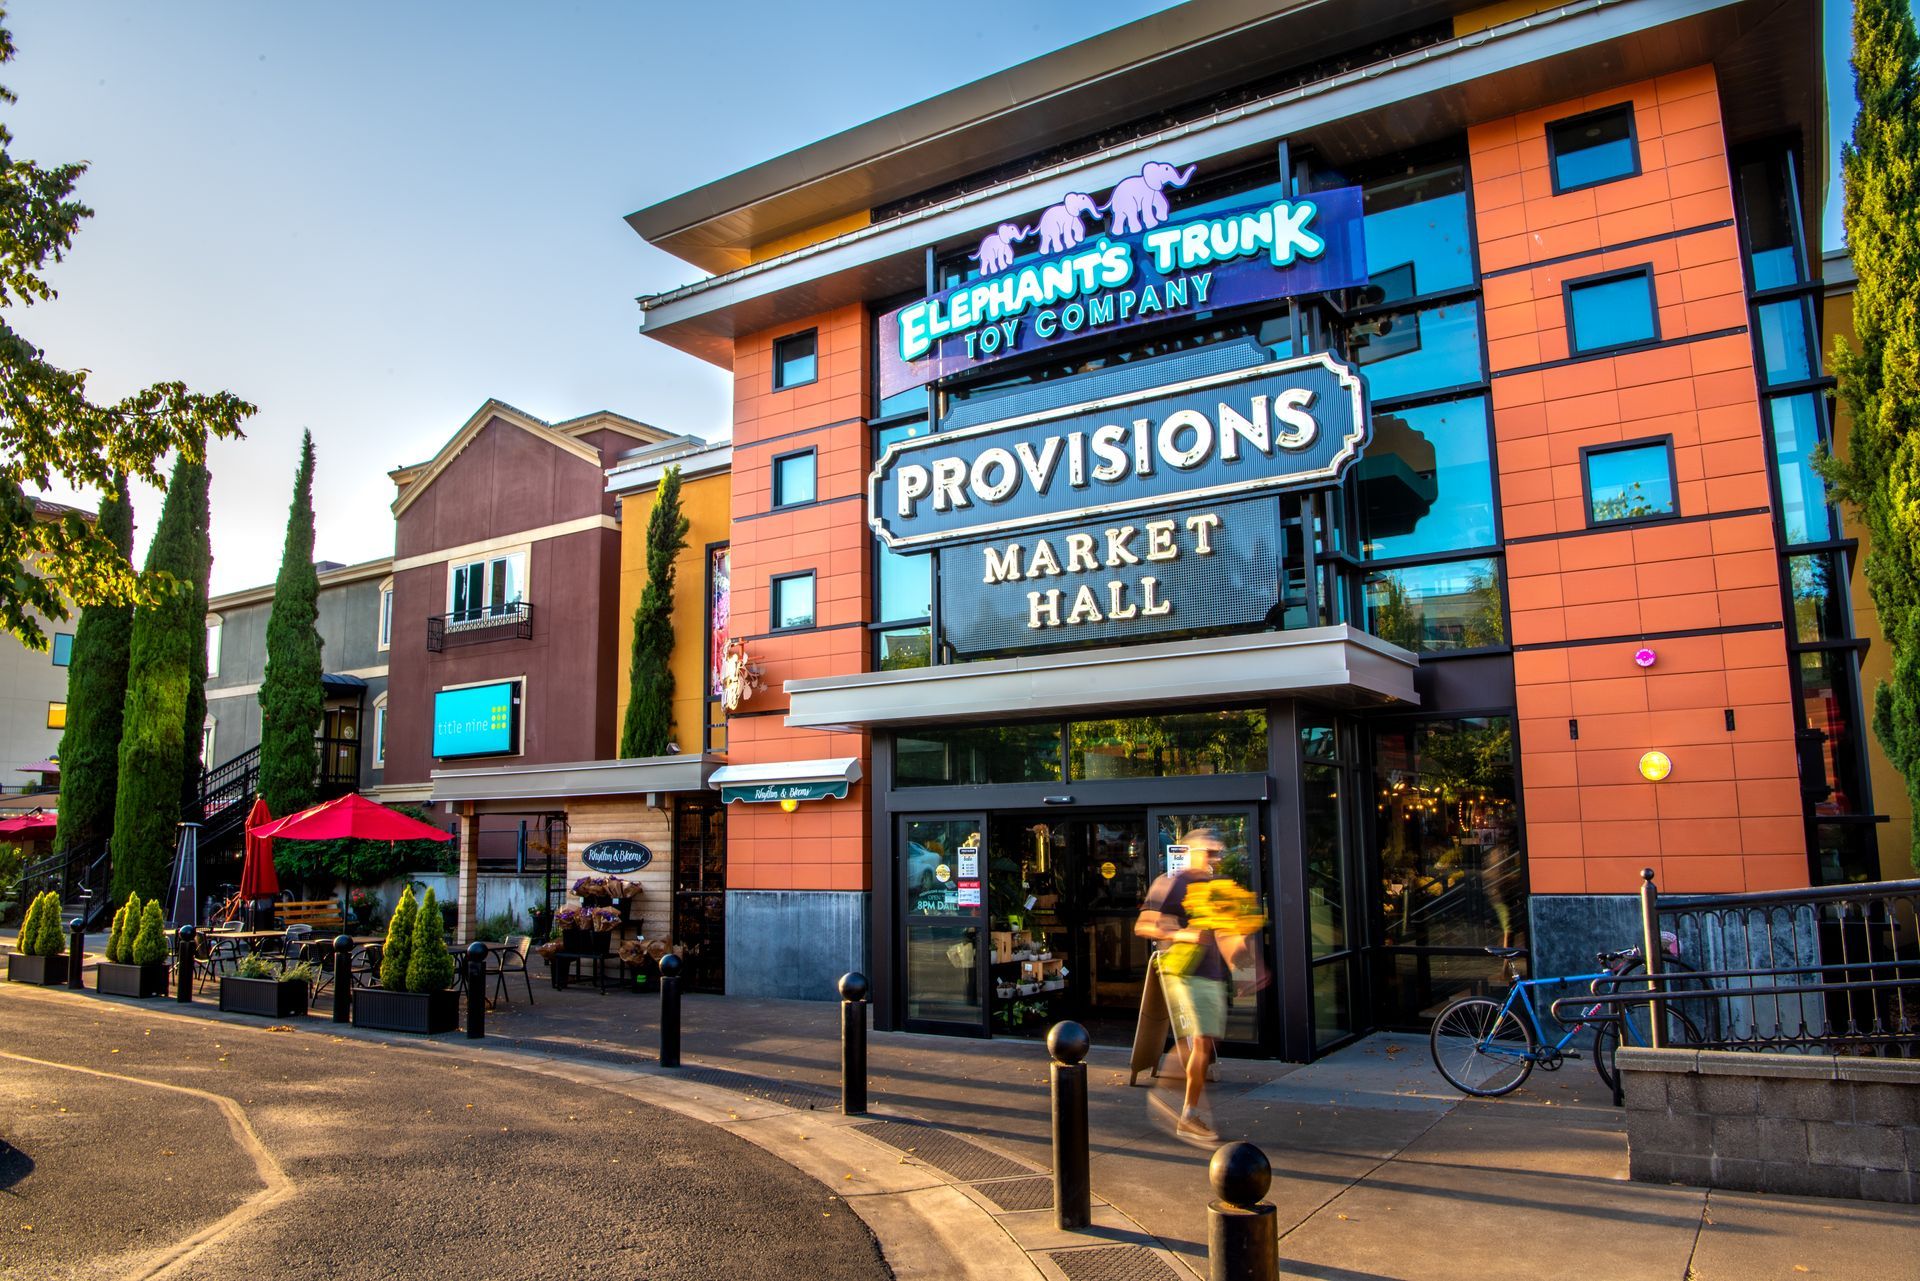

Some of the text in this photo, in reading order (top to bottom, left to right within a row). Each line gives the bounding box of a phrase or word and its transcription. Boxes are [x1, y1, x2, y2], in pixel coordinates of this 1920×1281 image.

[899, 201, 1324, 361] ELEPHANT'S TRUNK
[965, 272, 1212, 358] TOY COMPANY
[898, 388, 1316, 518] PROVISIONS
[983, 513, 1221, 584] MARKET
[1027, 576, 1170, 628] HALL
[438, 719, 489, 736] title nine
[780, 787, 787, 798] &
[613, 849, 620, 861] &
[917, 900, 936, 910] 8PM
